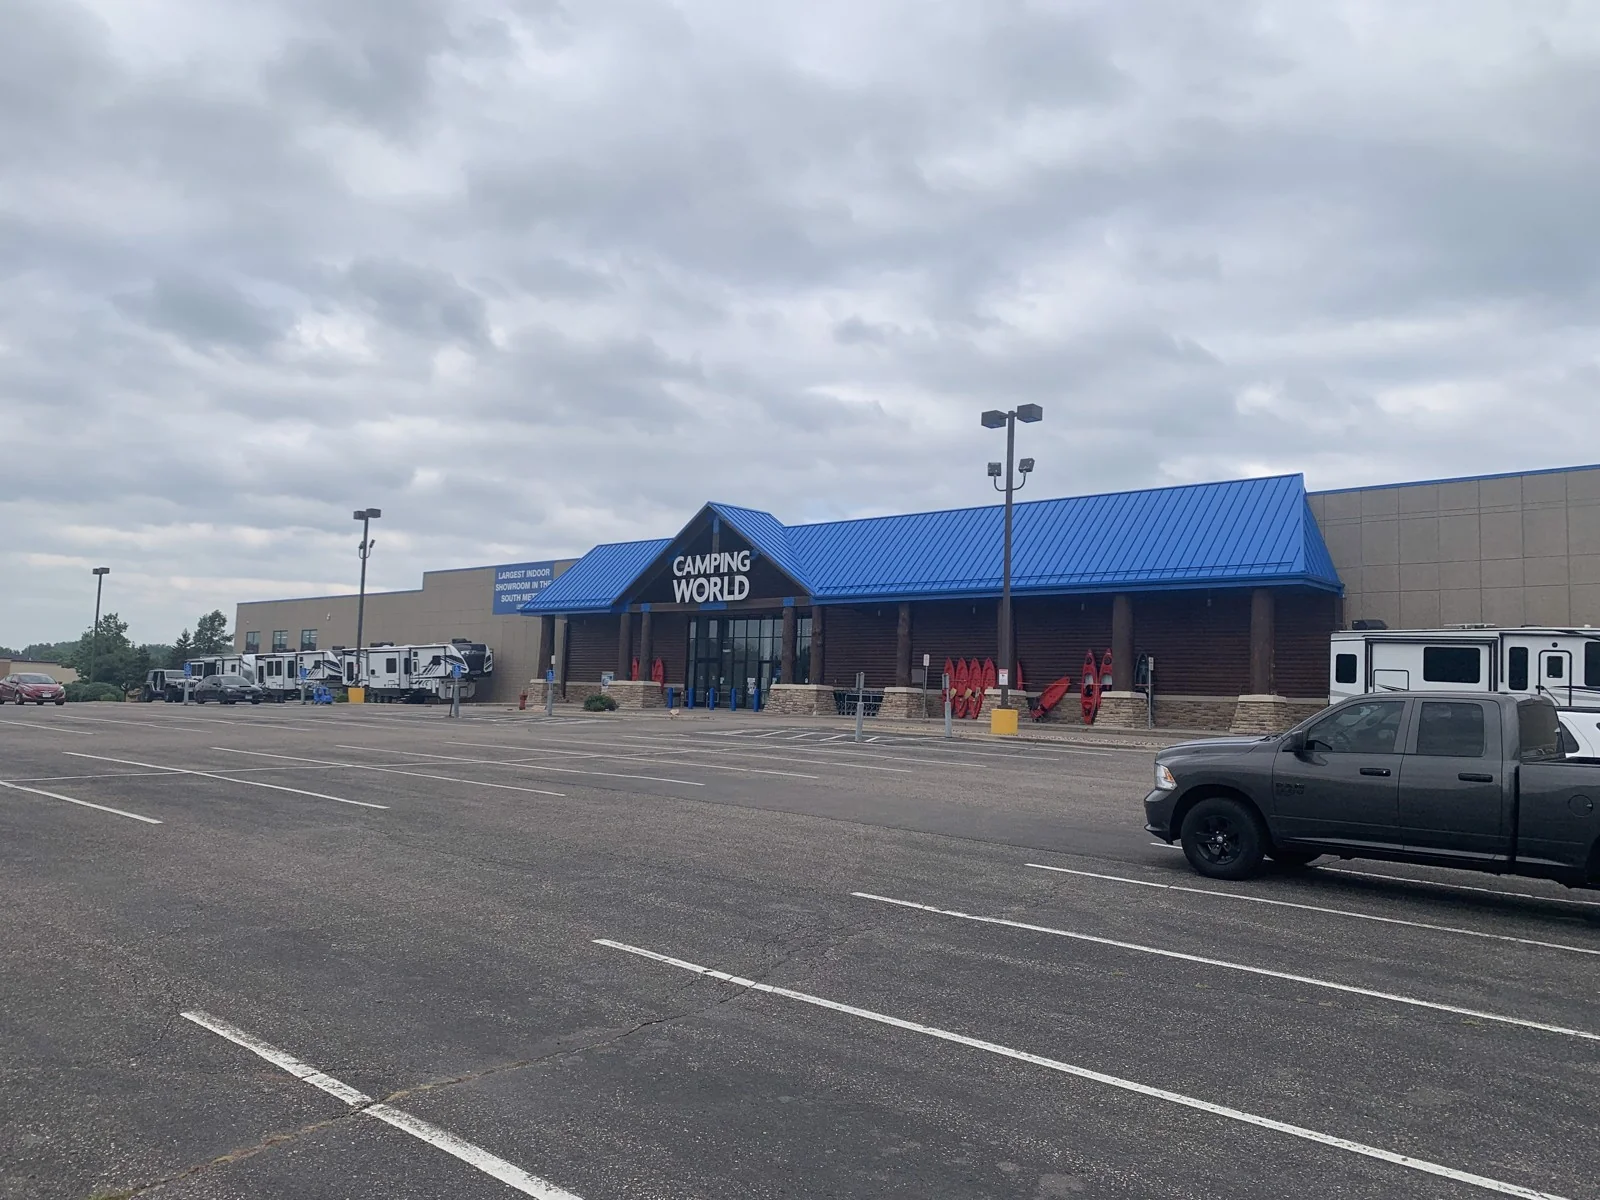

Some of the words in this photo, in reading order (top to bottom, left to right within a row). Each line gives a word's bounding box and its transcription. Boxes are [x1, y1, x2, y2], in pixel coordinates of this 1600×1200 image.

[673, 550, 751, 576] CAMPING
[498, 570, 525, 579] LARGEST
[526, 569, 550, 577] INDOOR
[496, 582, 531, 591] SHOWROOM
[673, 575, 750, 603] WORLD
[501, 594, 521, 602] SOUTH
